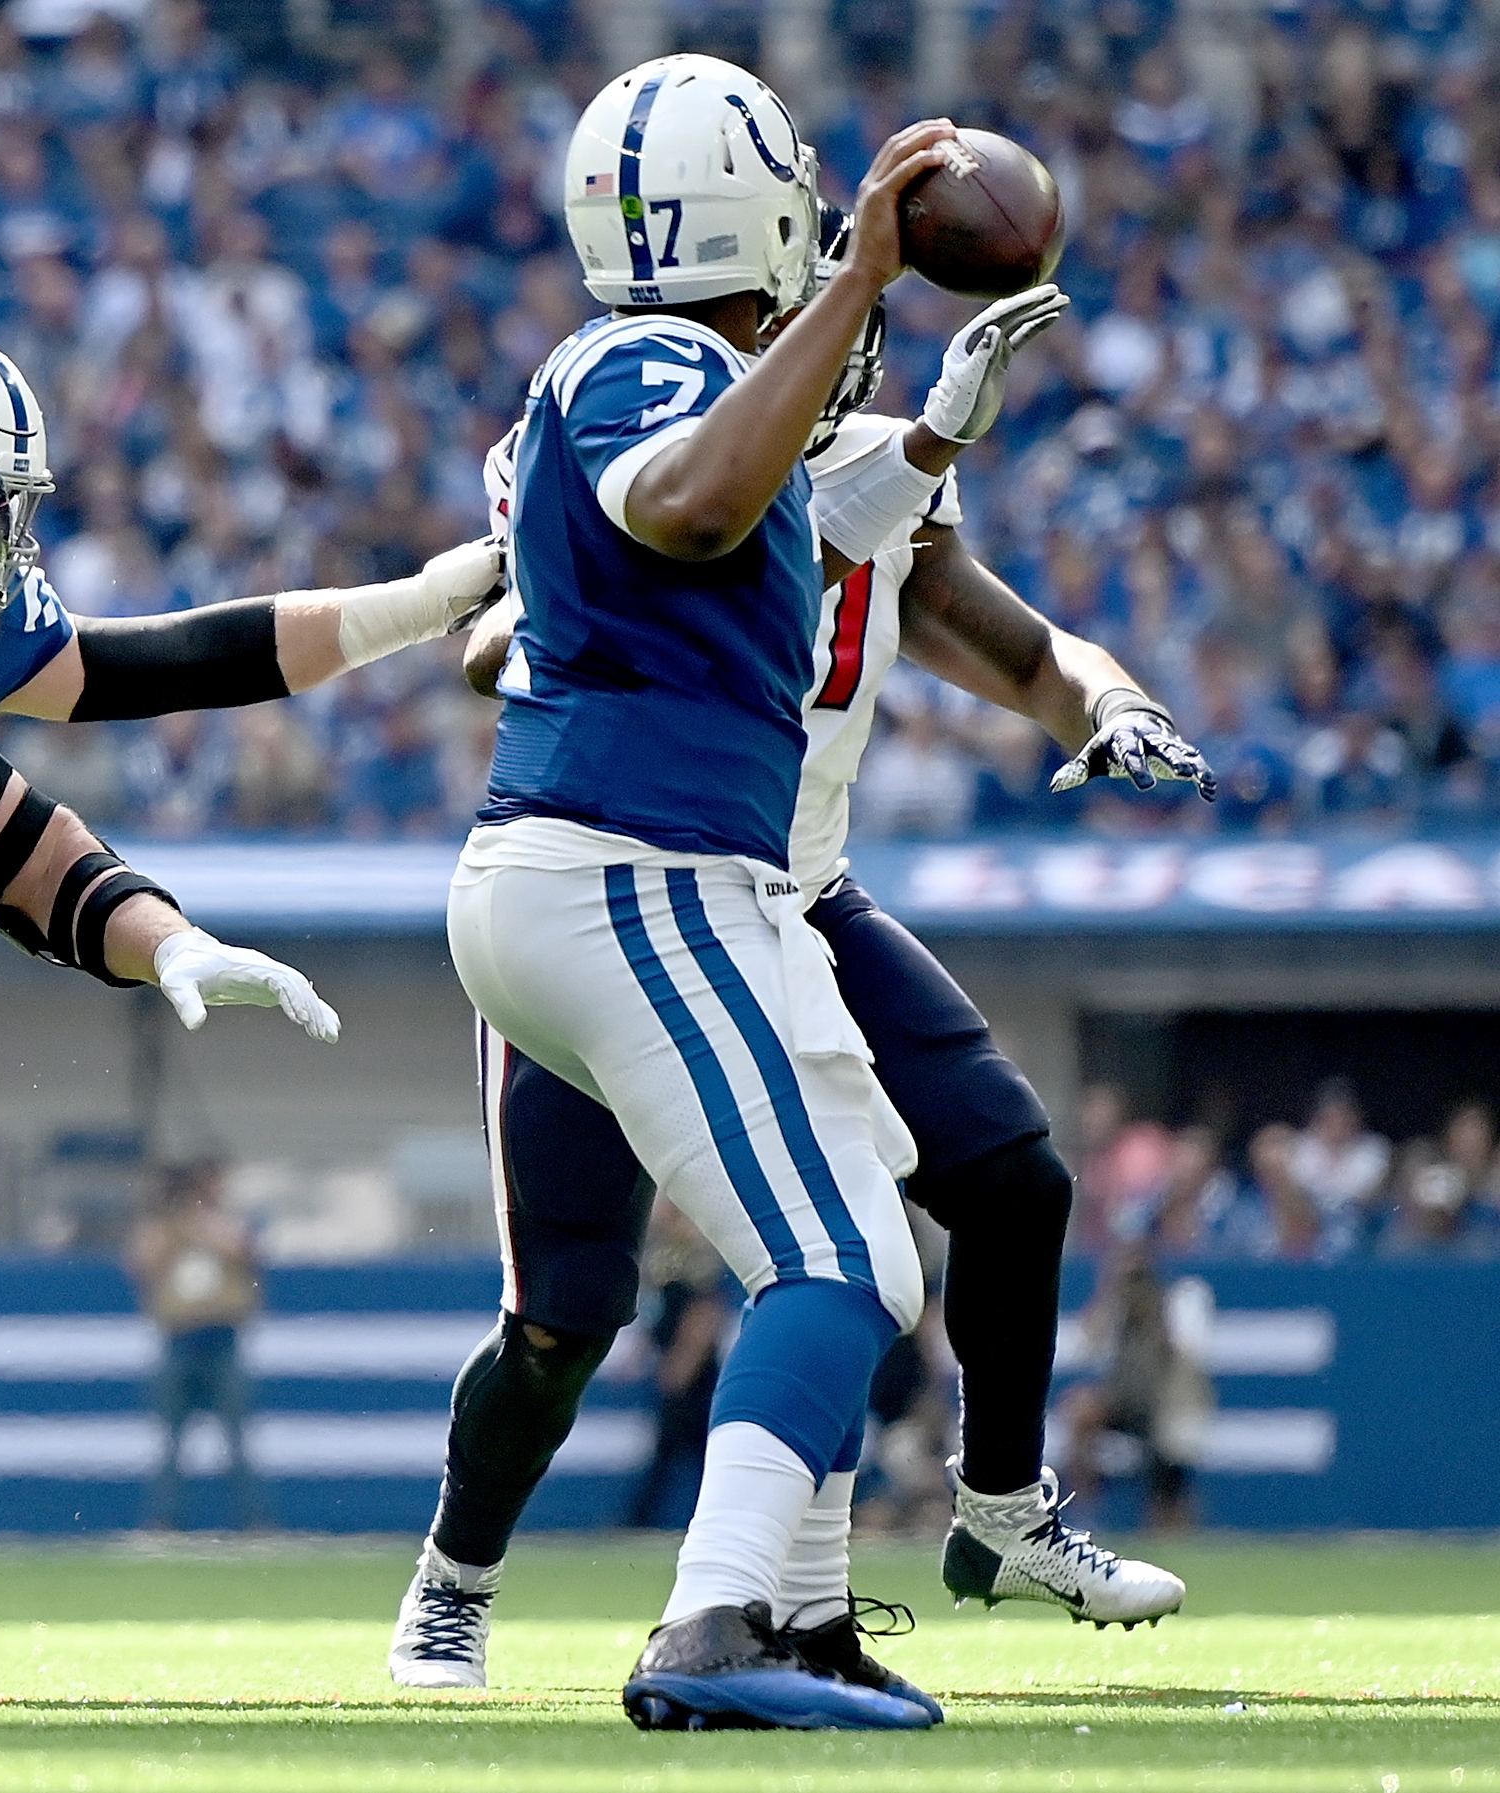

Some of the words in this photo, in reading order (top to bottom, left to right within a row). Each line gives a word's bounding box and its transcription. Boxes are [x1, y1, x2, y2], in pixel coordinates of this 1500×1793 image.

[649, 199, 683, 267] 7
[641, 360, 706, 430] 7
[908, 842, 1500, 912] LUCA
